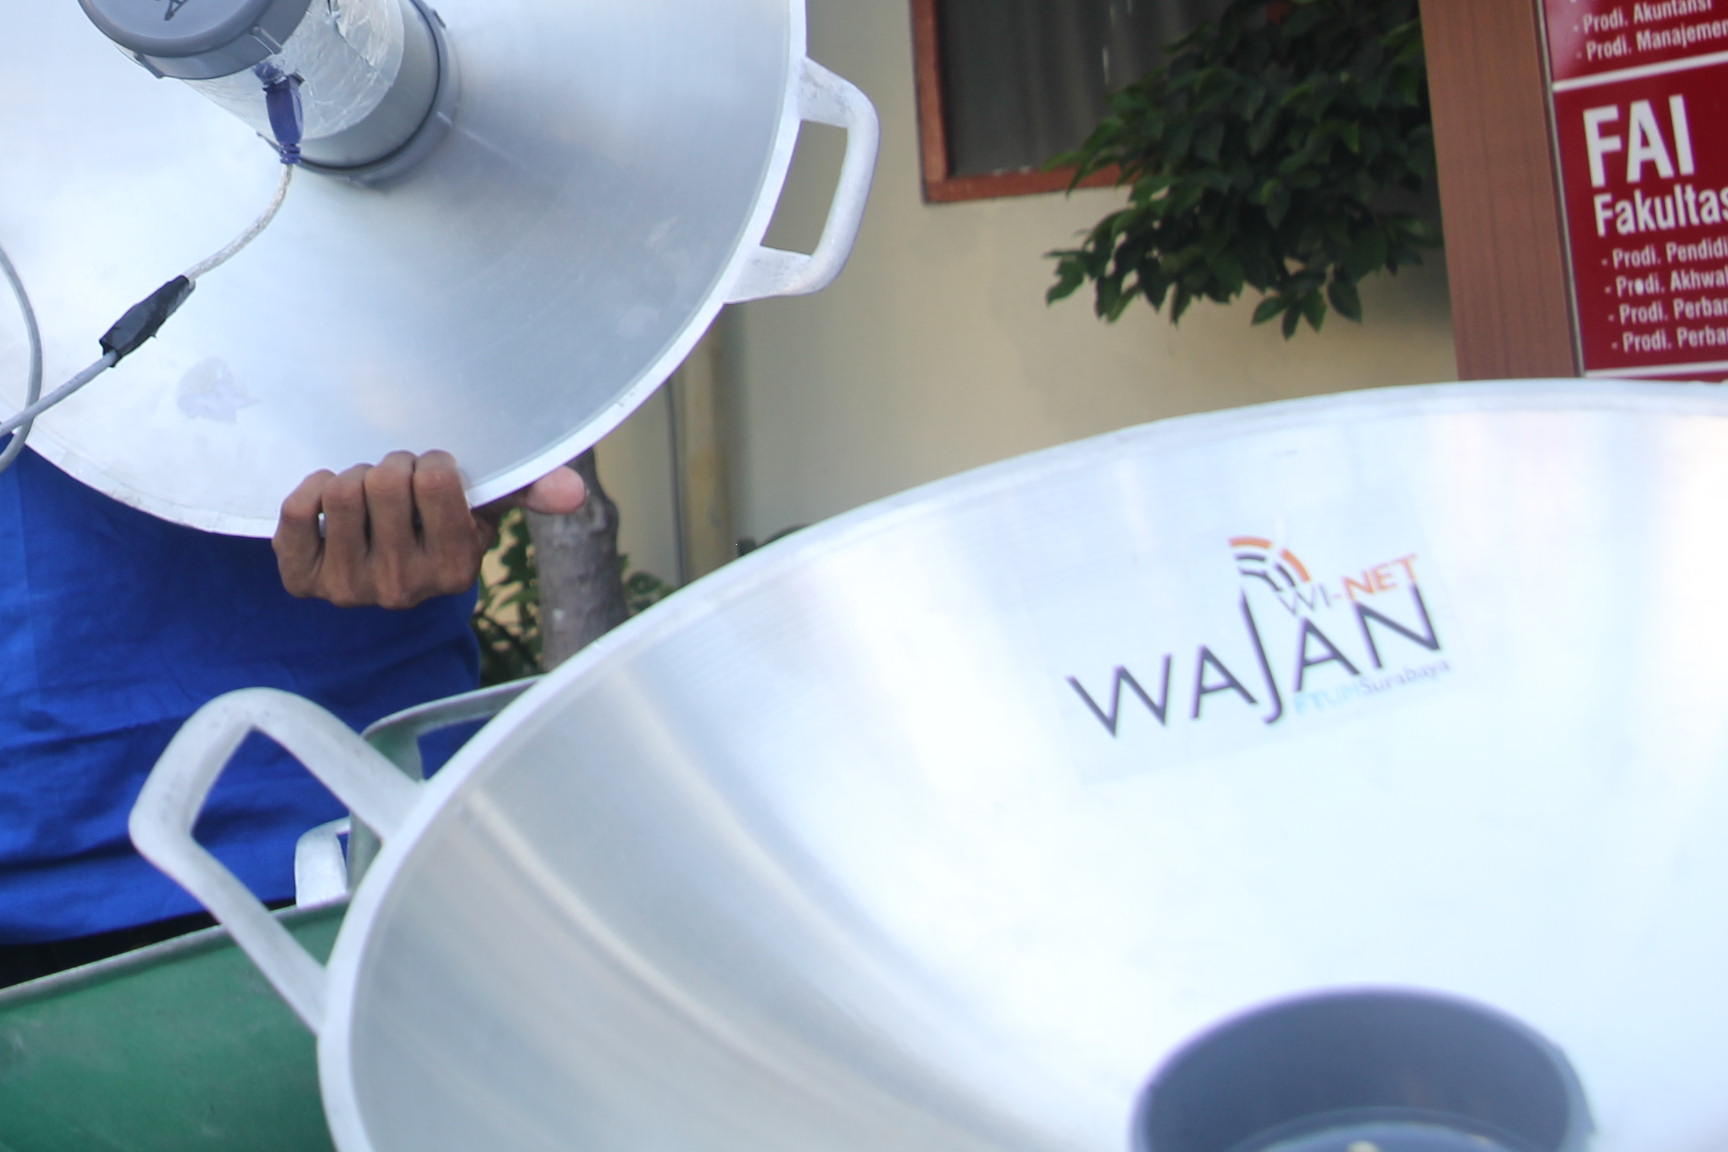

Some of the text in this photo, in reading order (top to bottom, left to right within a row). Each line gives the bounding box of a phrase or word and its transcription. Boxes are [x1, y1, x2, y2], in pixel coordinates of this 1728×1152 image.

[1583, 7, 1628, 34] Prodi.
[1586, 34, 1632, 61] Prodi.
[1583, 94, 1695, 189] FAI
[1612, 244, 1661, 269] Prodi.
[1616, 273, 1665, 298] Prodi.
[1619, 301, 1669, 325] Prodi.
[1623, 325, 1728, 353] Prodi. Perba
[1276, 553, 1418, 617] WI-NET
[1066, 582, 1441, 738] WAJAN
